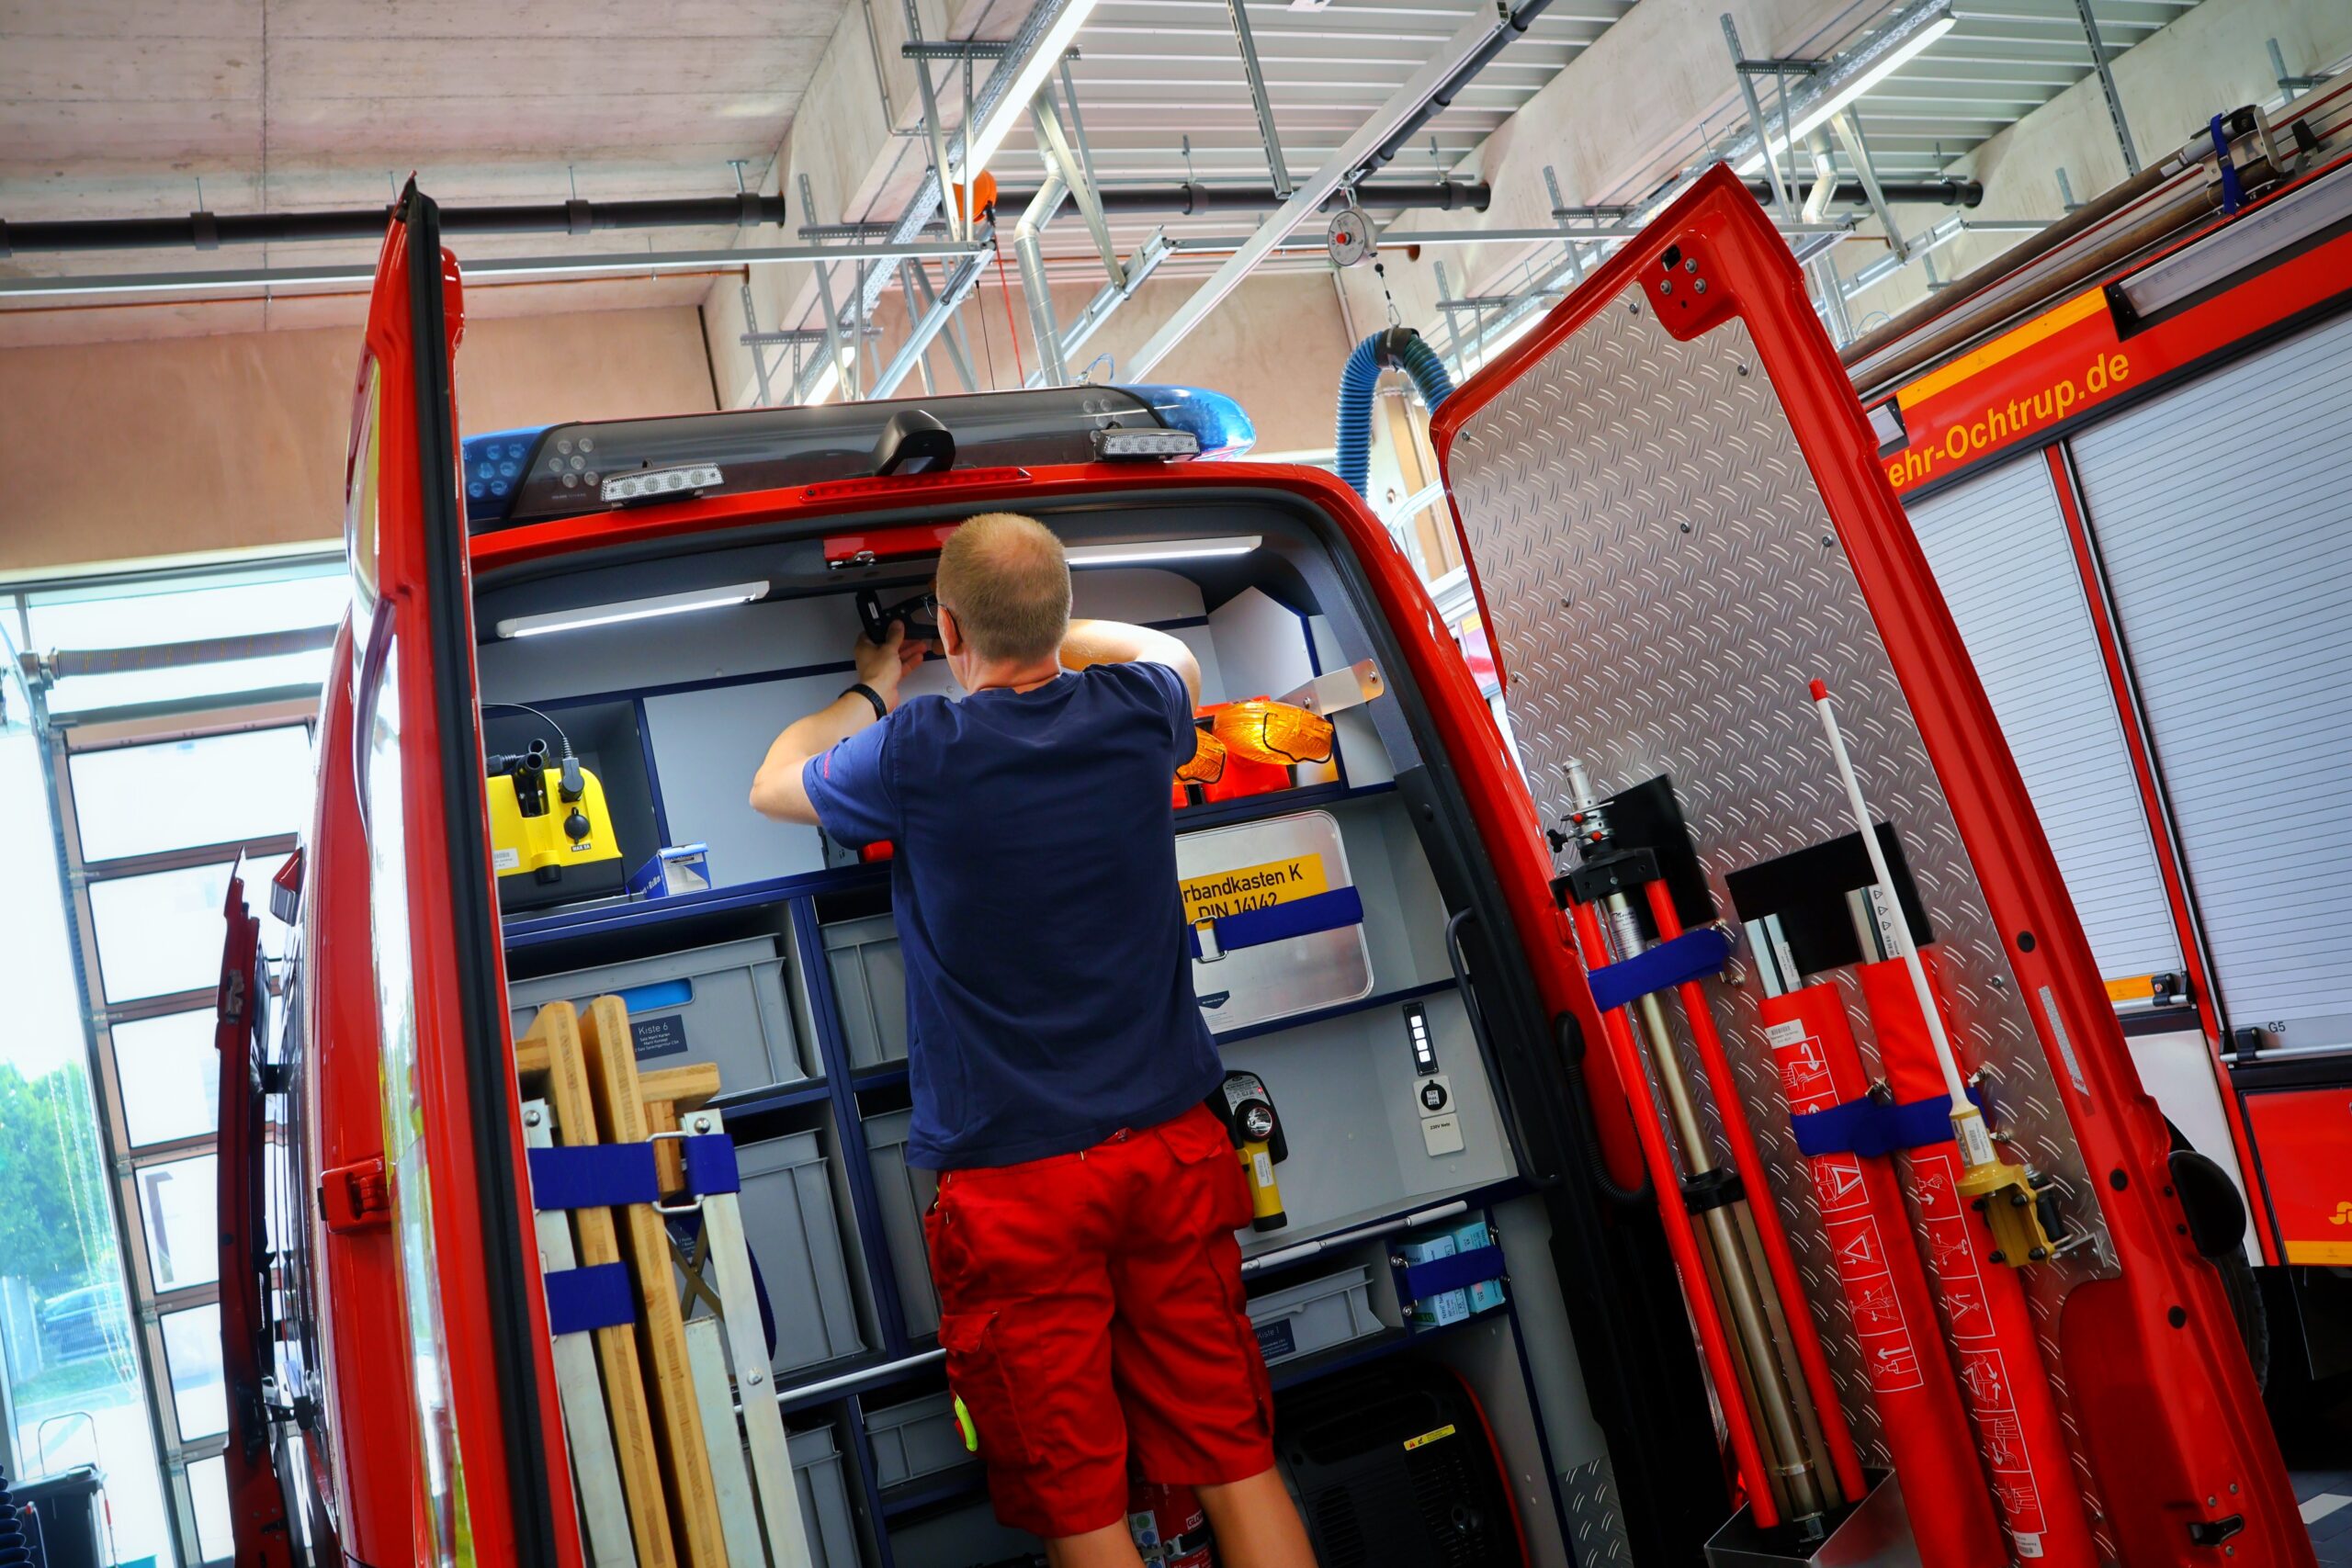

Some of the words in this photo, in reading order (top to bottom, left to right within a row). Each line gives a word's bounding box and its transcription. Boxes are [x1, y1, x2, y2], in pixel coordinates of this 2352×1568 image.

[1885, 353, 2130, 488] ehr-Ochtrup.de
[1182, 872, 1286, 903] rbandkasten
[1288, 863, 1304, 882] K
[1198, 901, 1230, 923] DIN
[639, 1025, 661, 1034] Kiste
[2267, 1021, 2287, 1033] G5
